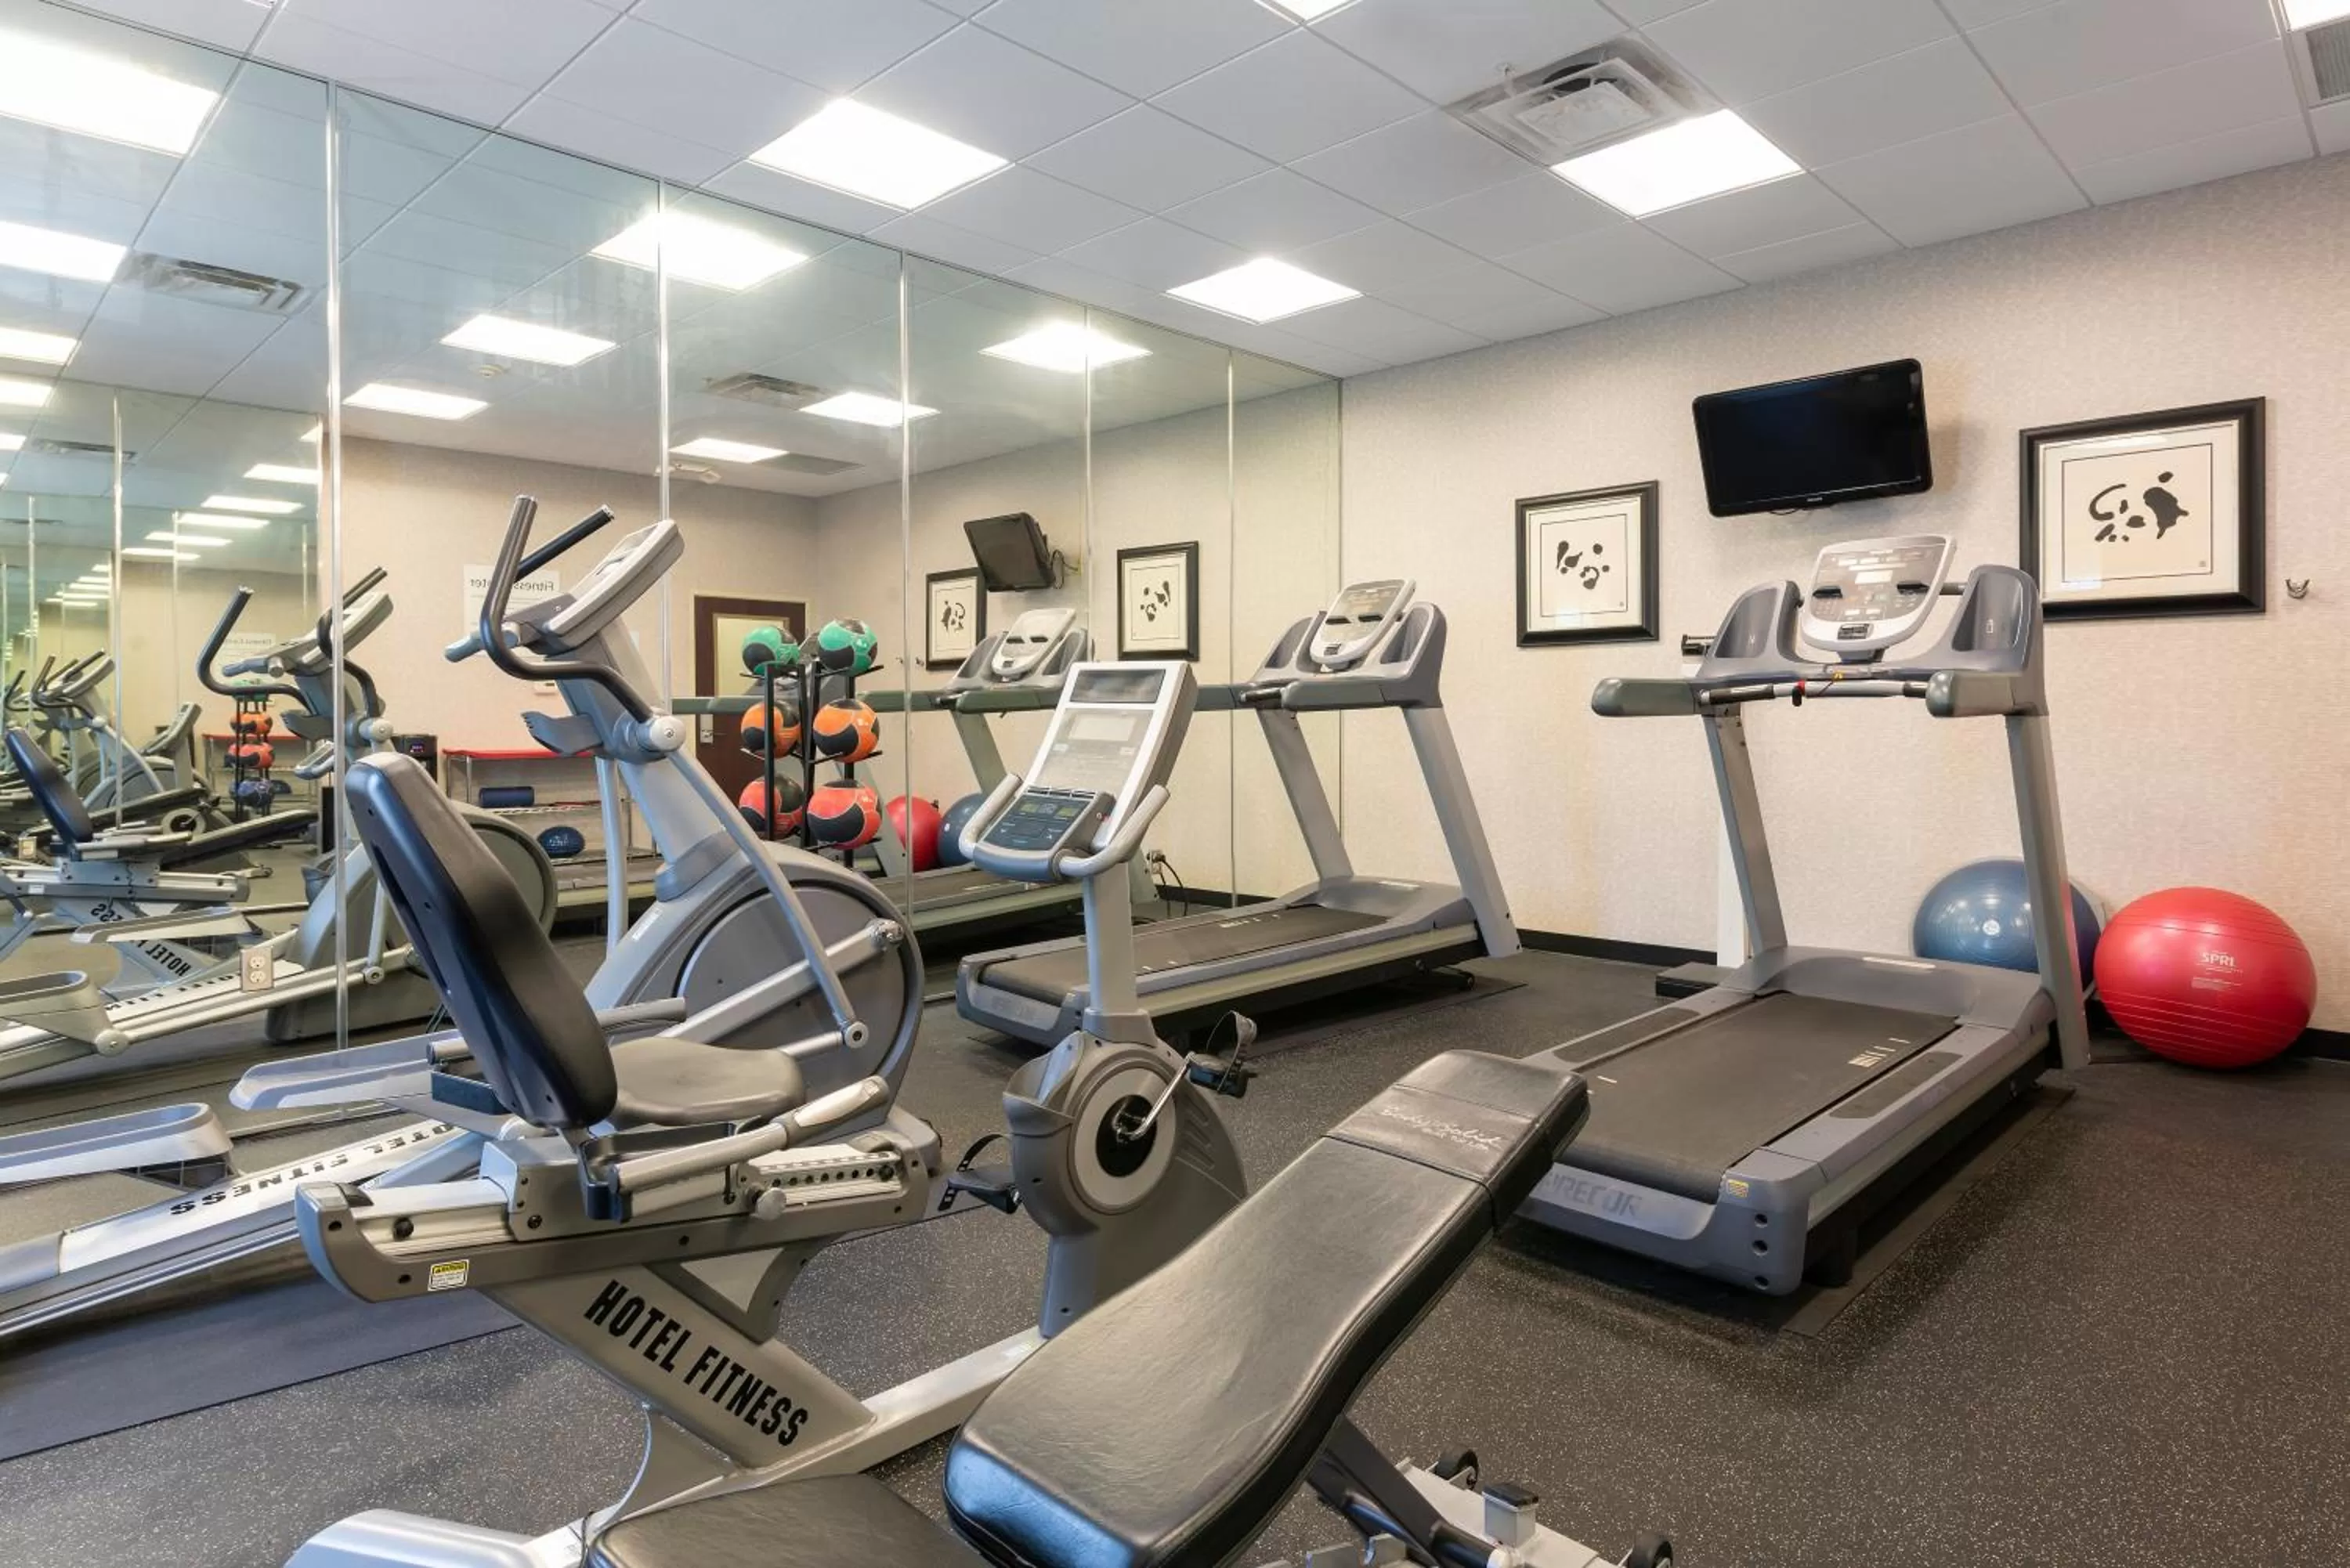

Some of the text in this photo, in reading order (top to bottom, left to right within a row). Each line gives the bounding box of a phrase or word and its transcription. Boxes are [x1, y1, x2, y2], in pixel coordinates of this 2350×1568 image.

[2200, 951, 2236, 967] SPRI
[170, 1123, 454, 1215] OTEL FITNESS
[584, 1279, 808, 1447] HOTEL FITNESS
